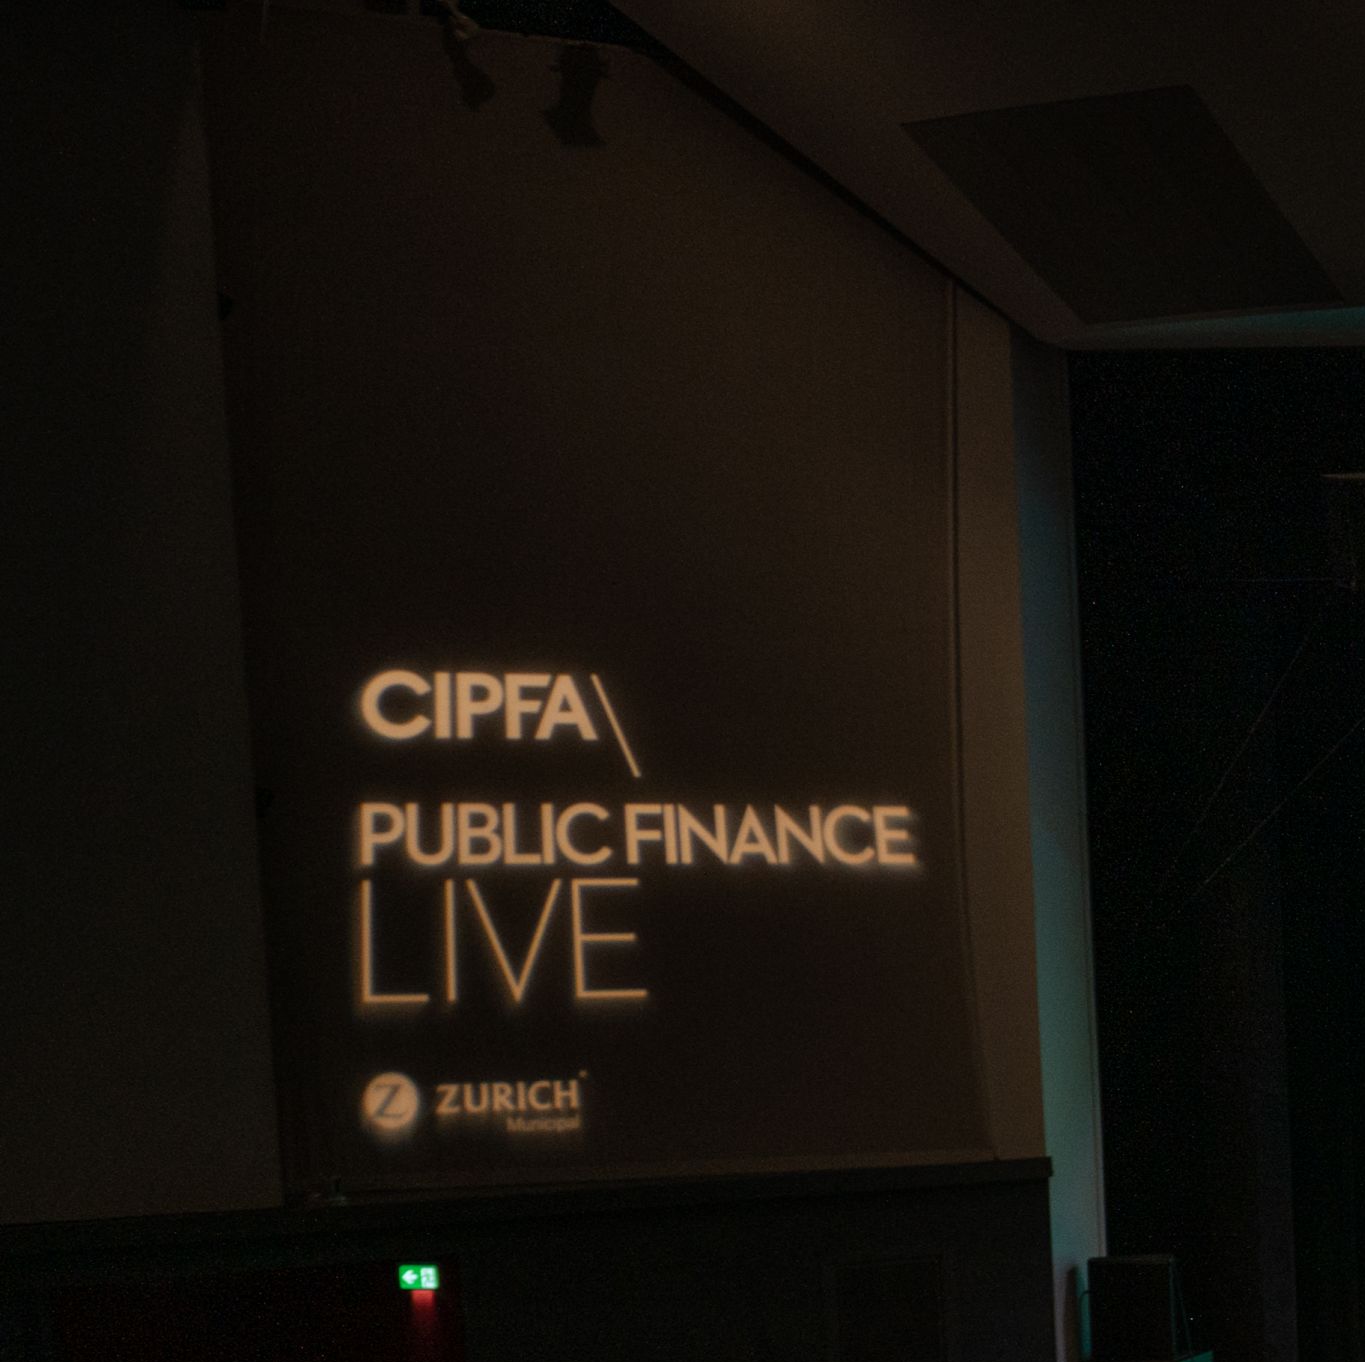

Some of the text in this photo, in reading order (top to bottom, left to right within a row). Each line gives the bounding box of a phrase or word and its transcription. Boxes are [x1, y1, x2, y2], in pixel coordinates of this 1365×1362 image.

[360, 802, 917, 866] PUBLIC FINANCE
[360, 877, 648, 1003] LIVE
[435, 1078, 580, 1116] ZURICH
[506, 1114, 580, 1133] Municipal
